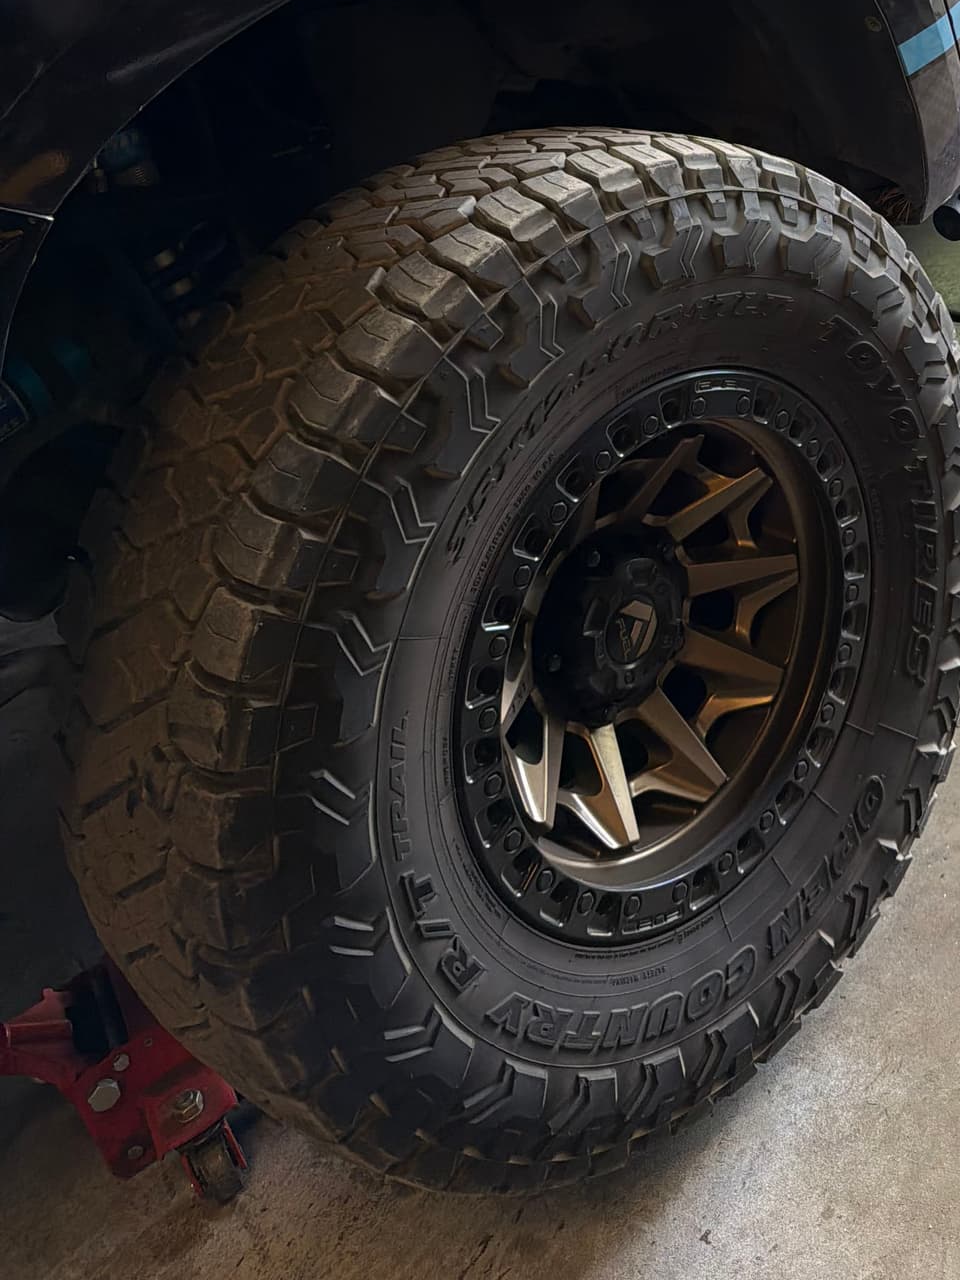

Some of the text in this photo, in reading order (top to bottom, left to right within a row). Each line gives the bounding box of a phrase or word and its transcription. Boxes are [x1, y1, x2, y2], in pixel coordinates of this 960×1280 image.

[390, 709, 416, 863] TRAIL
[765, 773, 886, 960] OPEN
[484, 942, 759, 1051] COUNTRY
